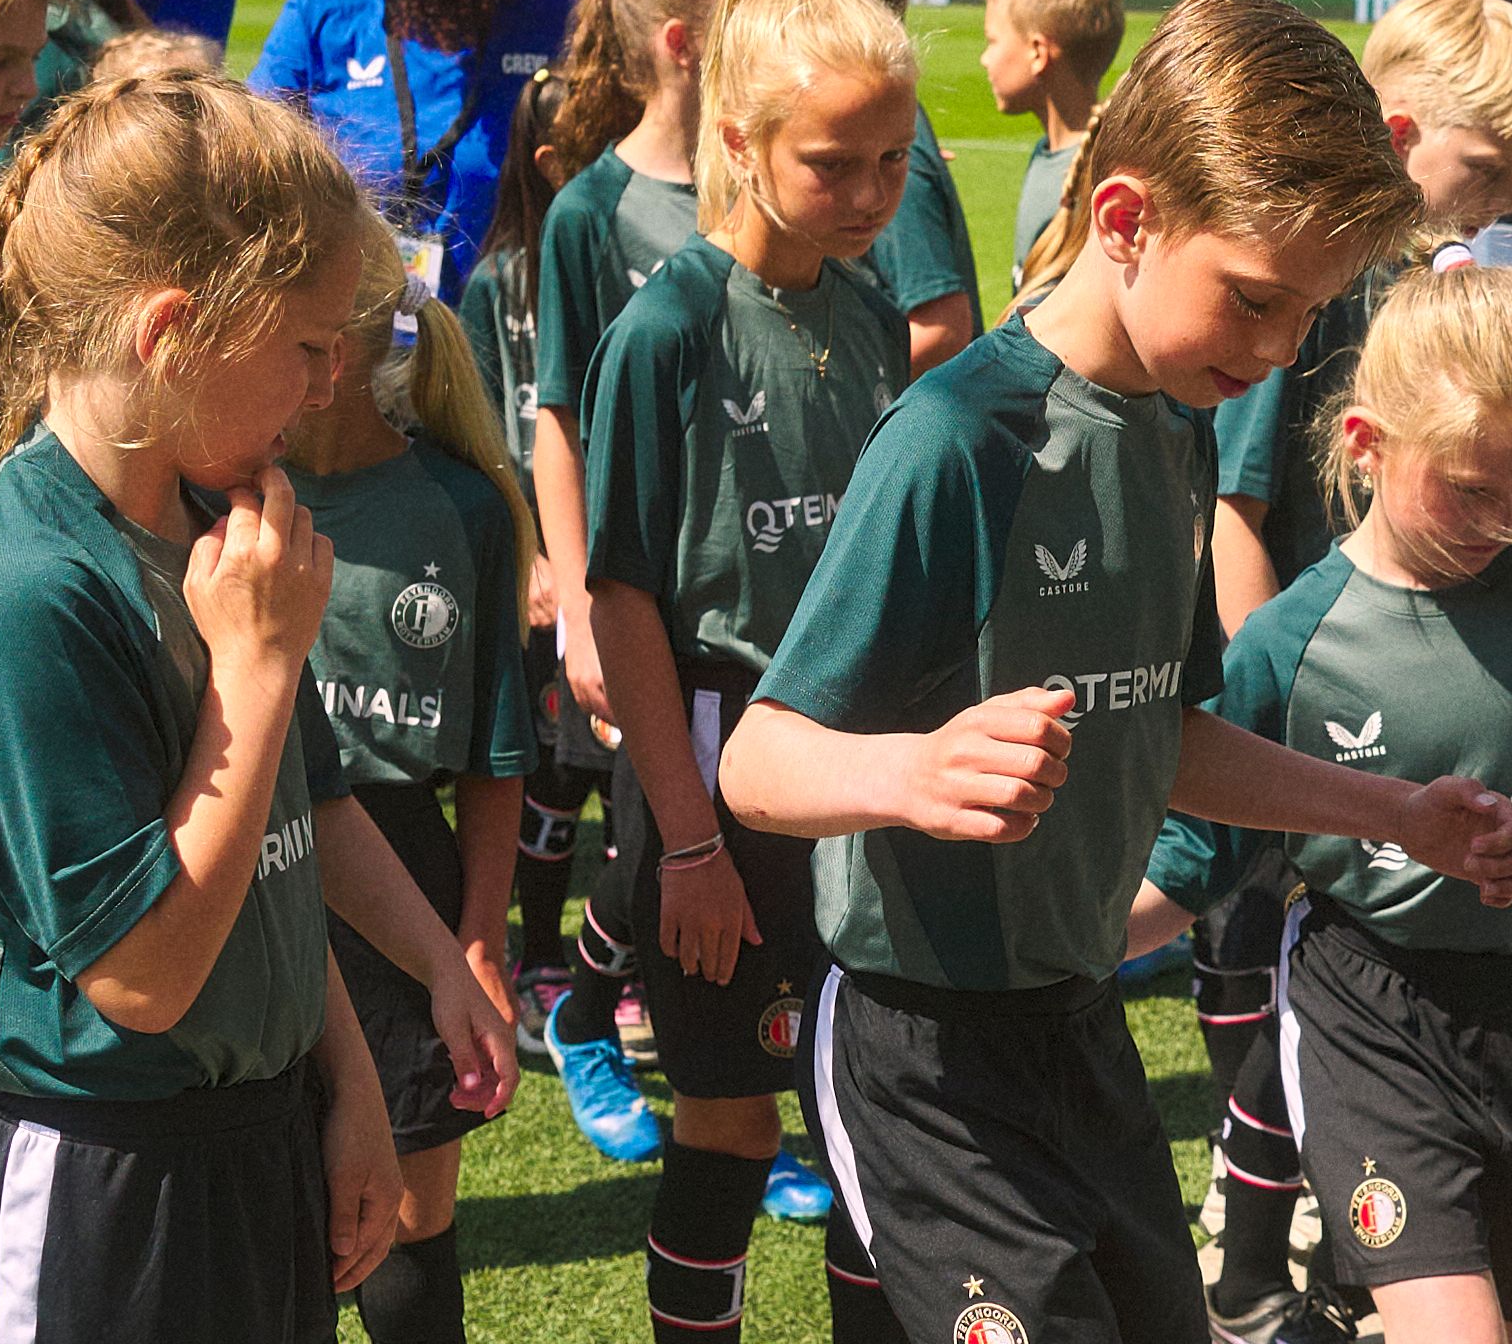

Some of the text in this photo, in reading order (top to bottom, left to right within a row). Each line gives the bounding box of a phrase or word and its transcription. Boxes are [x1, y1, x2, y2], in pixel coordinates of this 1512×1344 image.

[1039, 581, 1090, 597] CASTORE
[316, 680, 442, 729] INALS
[1336, 744, 1387, 763] CASTORE
[957, 1307, 1017, 1340] FEYENOORD
